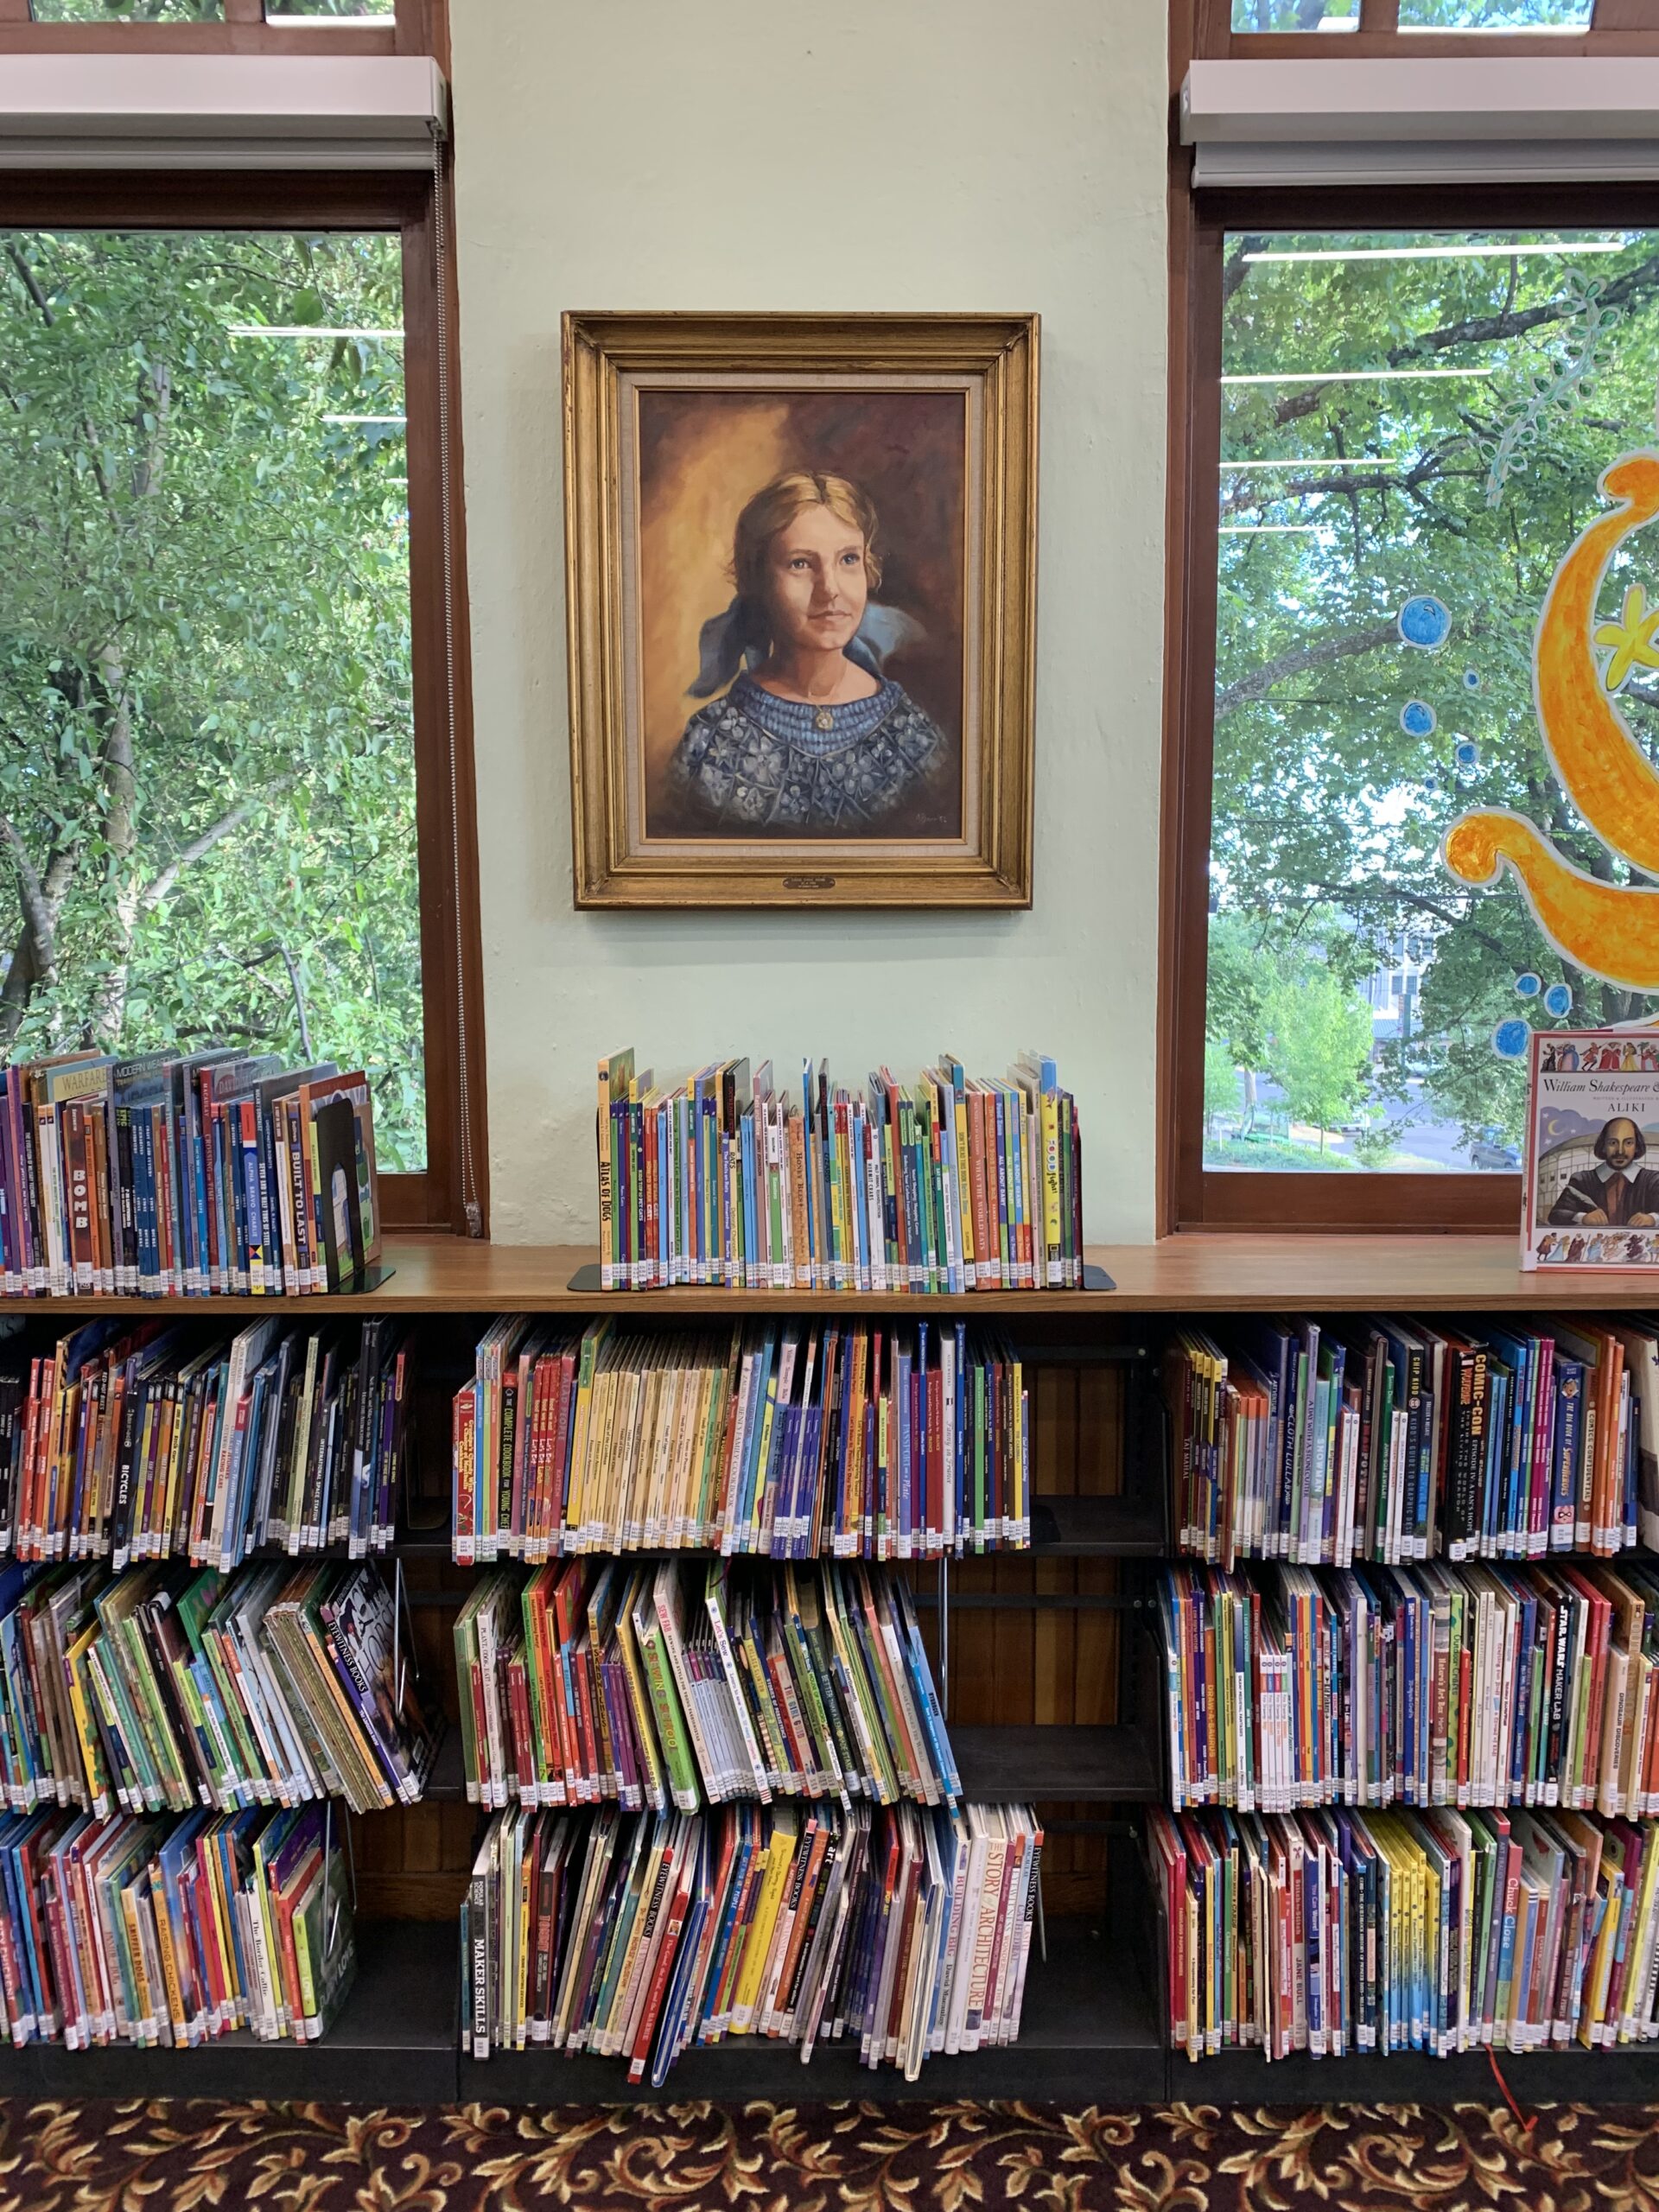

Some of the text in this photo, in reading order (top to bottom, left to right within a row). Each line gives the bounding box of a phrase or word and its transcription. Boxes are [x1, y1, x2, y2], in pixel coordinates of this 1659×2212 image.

[1543, 1078, 1586, 1092] William
[1589, 1078, 1650, 1095] Shakespeare
[1607, 1103, 1645, 1112] ALIKI
[1046, 1138, 1058, 1193] FOOD fight!
[73, 1170, 87, 1228] BOMB
[291, 1151, 306, 1243] BUILT TO LAST
[600, 1161, 611, 1221] ATLAS OF DOGS
[1410, 1357, 1420, 1394] CHIP KIDD
[1459, 1368, 1471, 1404] WOLVERINE
[1471, 1354, 1486, 1435] COMIC-CON
[502, 1408, 513, 1440] COMPLETE
[557, 1372, 569, 1440] SALAD PEOPLE
[734, 1406, 745, 1429] BENI'S
[1564, 1402, 1574, 1411] THE
[1564, 1412, 1573, 1421] BIG
[732, 1433, 742, 1459] FAMILY
[1563, 1423, 1573, 1437] BOOK
[315, 1438, 325, 1479] INTERNATIONAL
[501, 1443, 512, 1478] COOKBOOK
[1181, 1452, 1190, 1479] MAHAL
[1301, 1447, 1312, 1497] STONECUTTER
[1313, 1438, 1324, 1491] SNOWMAN
[1407, 1469, 1414, 1479] TO
[1468, 1440, 1478, 1470] EPISODE
[1583, 1445, 1592, 1499] CONFIDENTIAL
[118, 1464, 129, 1504] BICYCLES
[499, 1490, 510, 1510] YOUNG
[726, 1461, 739, 1507] COOKBOOK
[1405, 1483, 1414, 1514] GRAPHIC
[1466, 1490, 1475, 1510] FAN'S
[311, 1498, 320, 1521] STATION
[499, 1513, 509, 1529] CHEF
[1404, 1516, 1413, 1535] DESI
[1465, 1512, 1474, 1530] HOPE
[656, 1604, 671, 1631] SEW FAB
[327, 1621, 367, 1691] EYEWITNESS BOOKS
[711, 1620, 730, 1656] Let's Sew
[1451, 1634, 1460, 1694] Outdoor Crafts
[1551, 1605, 1568, 1719] STAR WARS MAKER LAB
[1436, 1658, 1446, 1713] Nature's Art Box
[1206, 1684, 1216, 1757] DRAW-A-SAURUS
[1612, 1692, 1624, 1768] DINOSAUR DISCOVERIES
[788, 1835, 813, 1908] EYEWITNESS BOOKS
[823, 1847, 836, 1864] art
[981, 1852, 1002, 1897] STORY
[643, 1863, 670, 1936] EYEWITNESS BOOKS
[1025, 1847, 1040, 1919] EYEWITNESS BOOKS
[946, 1875, 965, 1956] BUILDING BIG
[1502, 1878, 1516, 1948] Chuck Close
[132, 1960, 145, 1982] DOGS
[158, 1918, 181, 2018] RAISING CHICKENS
[254, 1938, 265, 1968] Border
[968, 1905, 995, 2006] ARCHITECTURE
[257, 1971, 269, 1996] Collie
[474, 1938, 486, 2032] MAKER SKILLS
[938, 1963, 953, 2025] David Macaulay
[1294, 1957, 1303, 2005] JANE BULL
